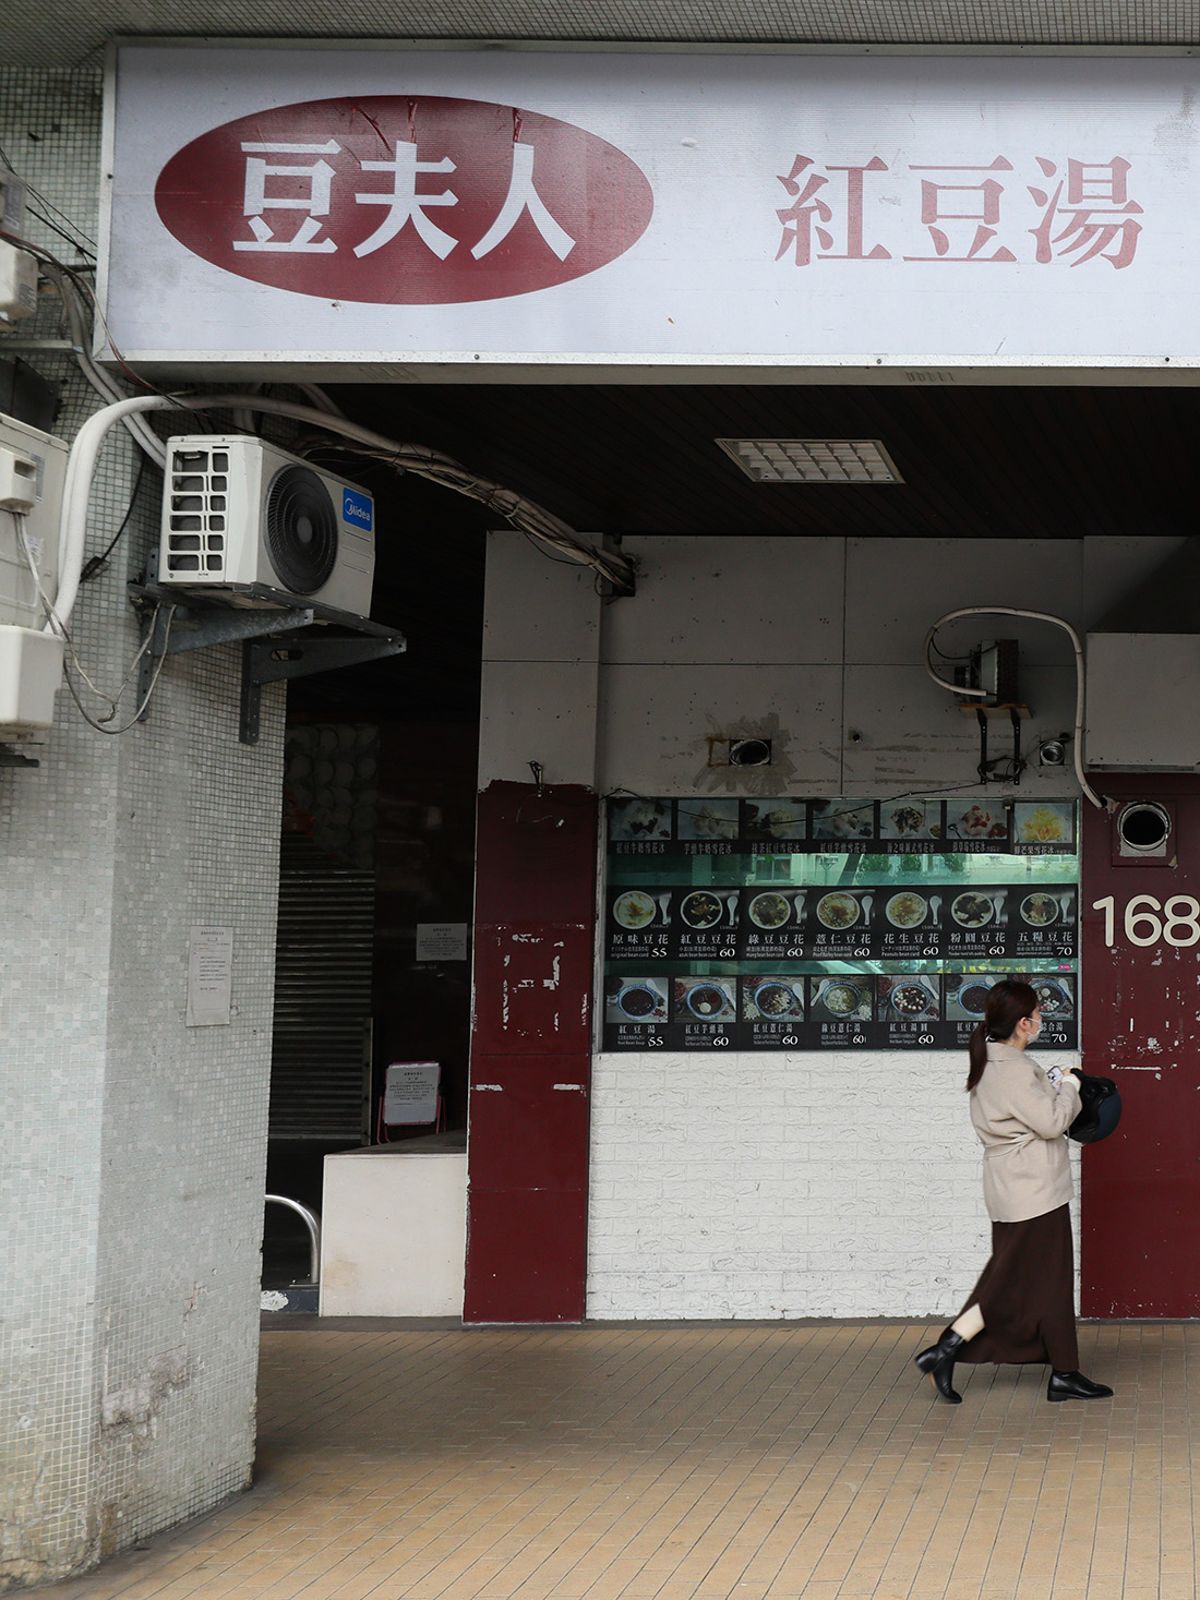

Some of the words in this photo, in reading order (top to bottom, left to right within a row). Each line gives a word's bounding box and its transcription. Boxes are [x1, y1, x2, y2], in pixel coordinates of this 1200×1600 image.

[233, 139, 577, 262] 豆夫人
[775, 153, 1145, 270] 紅豆湯
[345, 498, 370, 521] Midea
[1092, 894, 1200, 948] 168
[613, 934, 669, 945] 原味豆花
[680, 934, 737, 945] 紅豆豆花
[748, 933, 804, 945] 綠豆豆花
[816, 933, 871, 944] 薏仁豆花
[884, 933, 939, 944] 花生豆花
[651, 947, 668, 958] 55
[719, 947, 736, 958] 60
[786, 947, 803, 957] 60
[853, 947, 871, 957] 60
[922, 946, 939, 956] 60
[988, 945, 1005, 955] 60
[1056, 946, 1073, 956] 70
[648, 1036, 664, 1047] 55
[713, 1036, 729, 1047] 60
[782, 1034, 798, 1045] 60
[852, 1034, 865, 1045] 60
[918, 1034, 934, 1044] 60
[1051, 1033, 1067, 1043] 70
